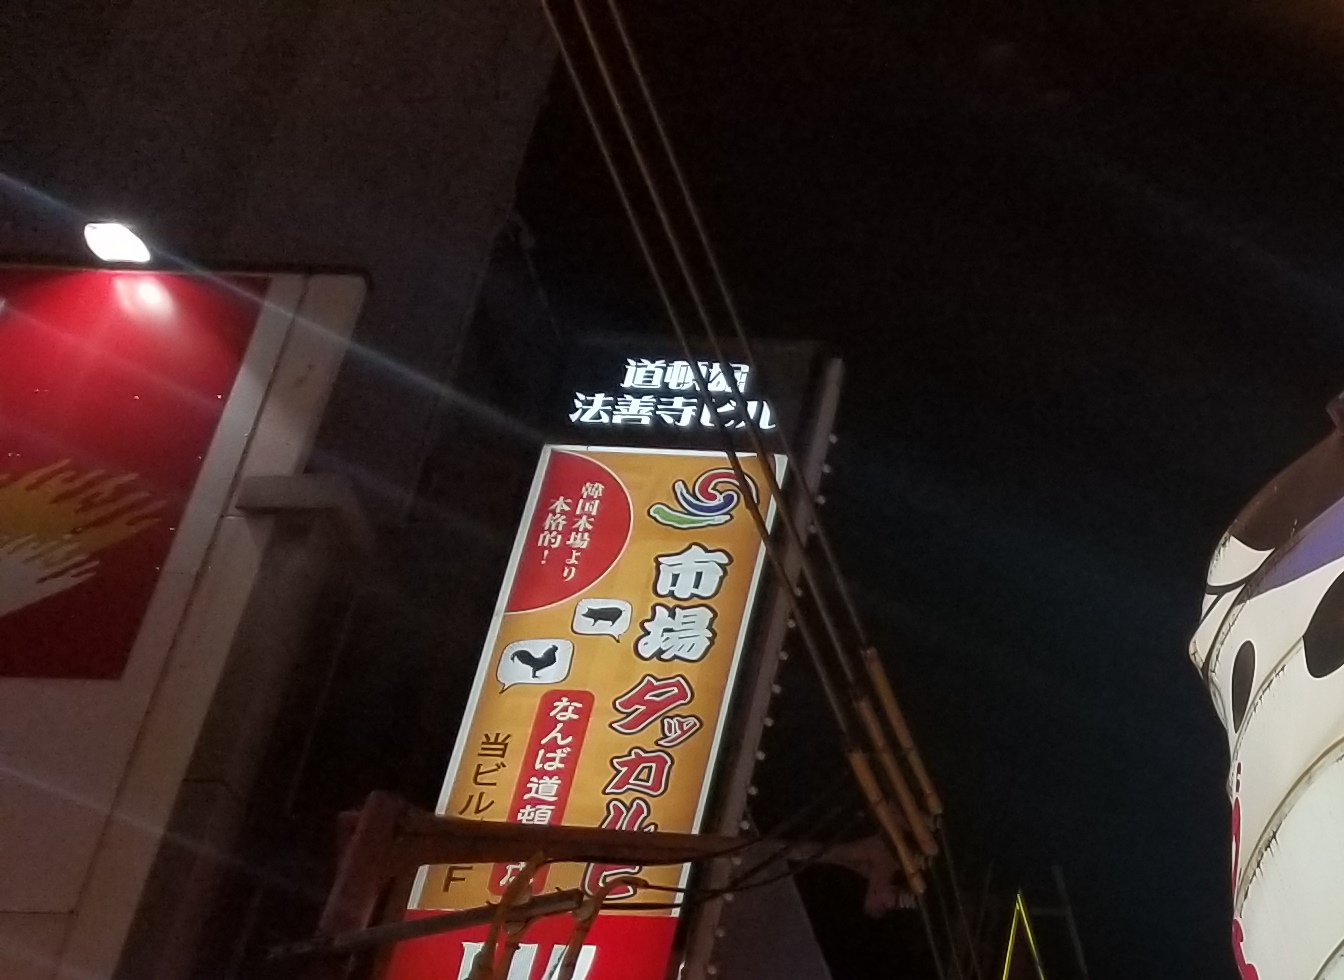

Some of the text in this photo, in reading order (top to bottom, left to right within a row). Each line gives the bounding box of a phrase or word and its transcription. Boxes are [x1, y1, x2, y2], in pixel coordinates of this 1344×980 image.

[620, 358, 750, 393] 道頓堀
[568, 392, 776, 430] 法善寺ビル
[562, 482, 605, 582] 韓国本場より
